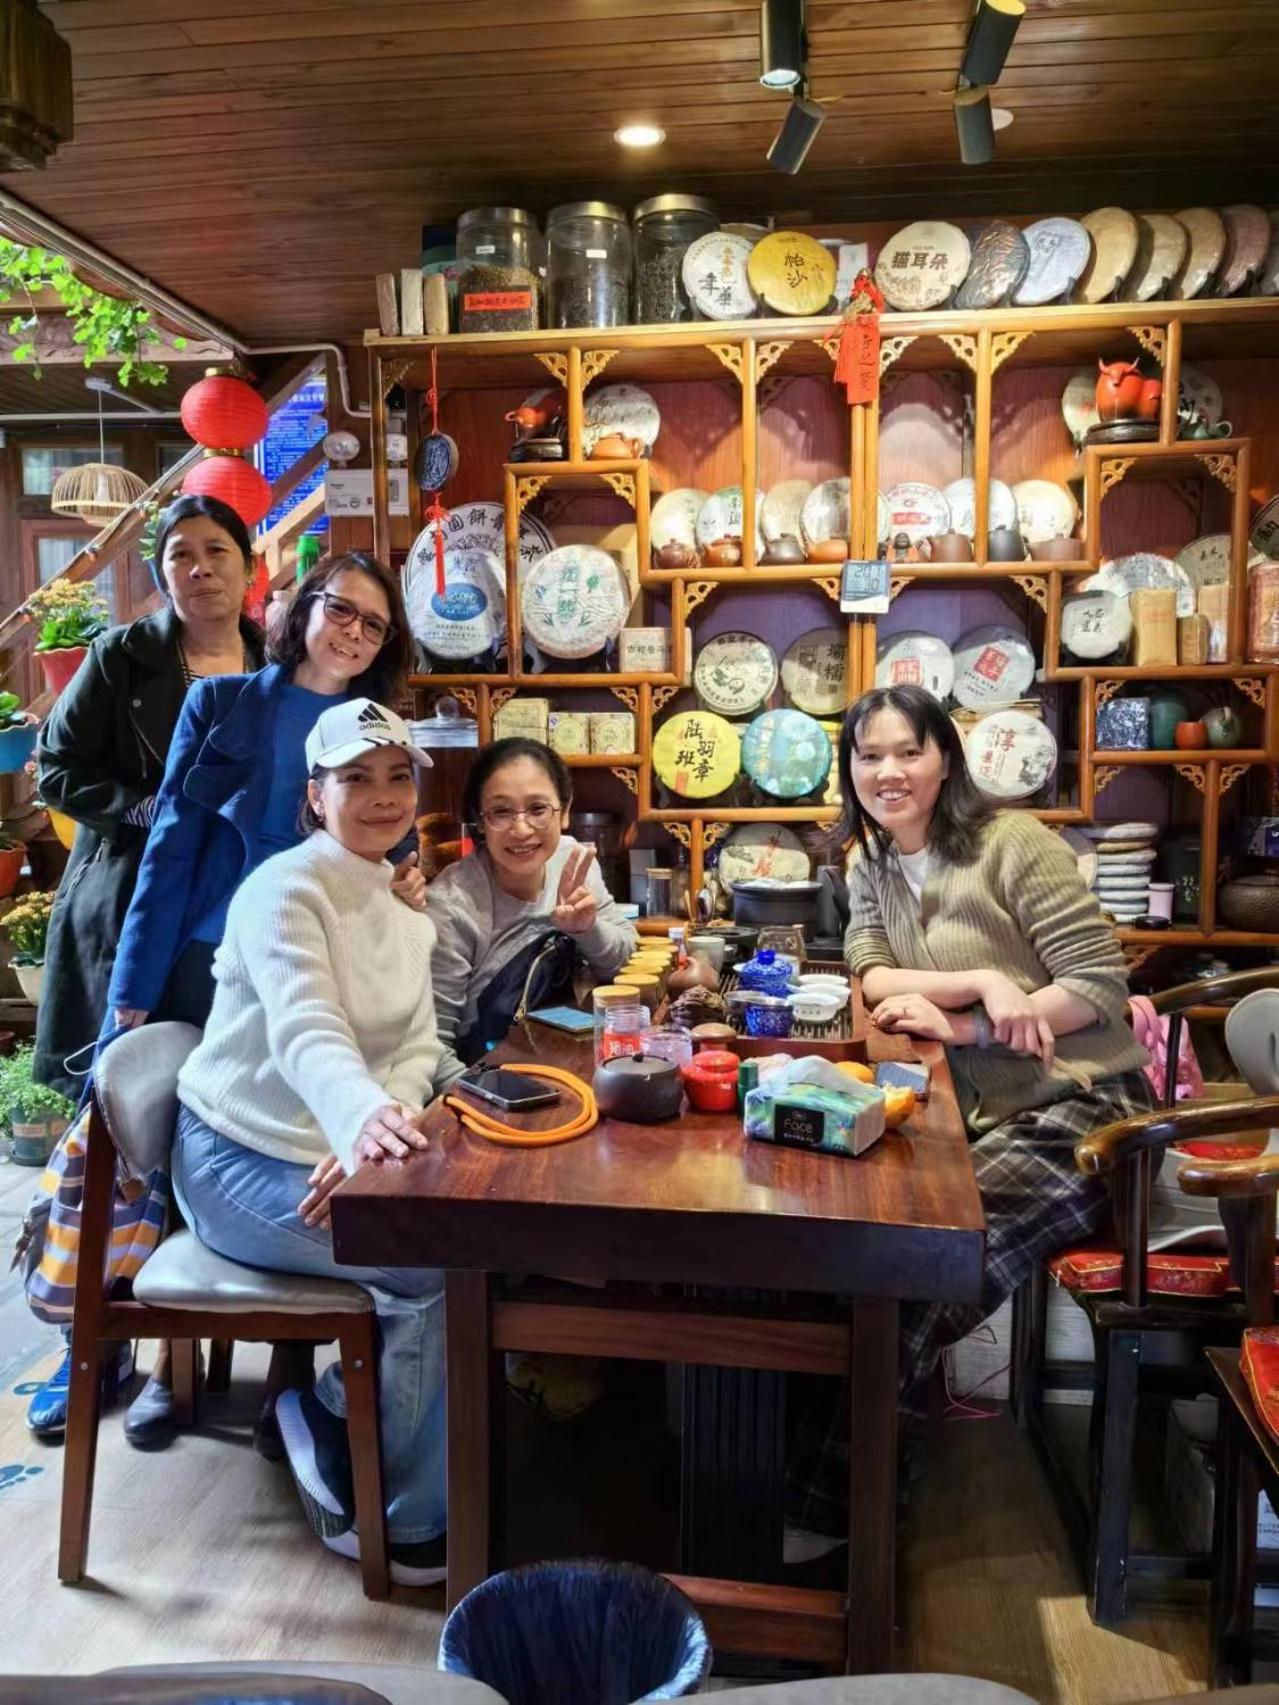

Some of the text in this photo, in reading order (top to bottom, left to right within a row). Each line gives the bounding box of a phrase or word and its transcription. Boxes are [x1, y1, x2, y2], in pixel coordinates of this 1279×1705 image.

[892, 251, 948, 271] 猫耳朵
[784, 252, 808, 289] 帕沙
[359, 721, 391, 731] adidas
[783, 1118, 814, 1134] Face
